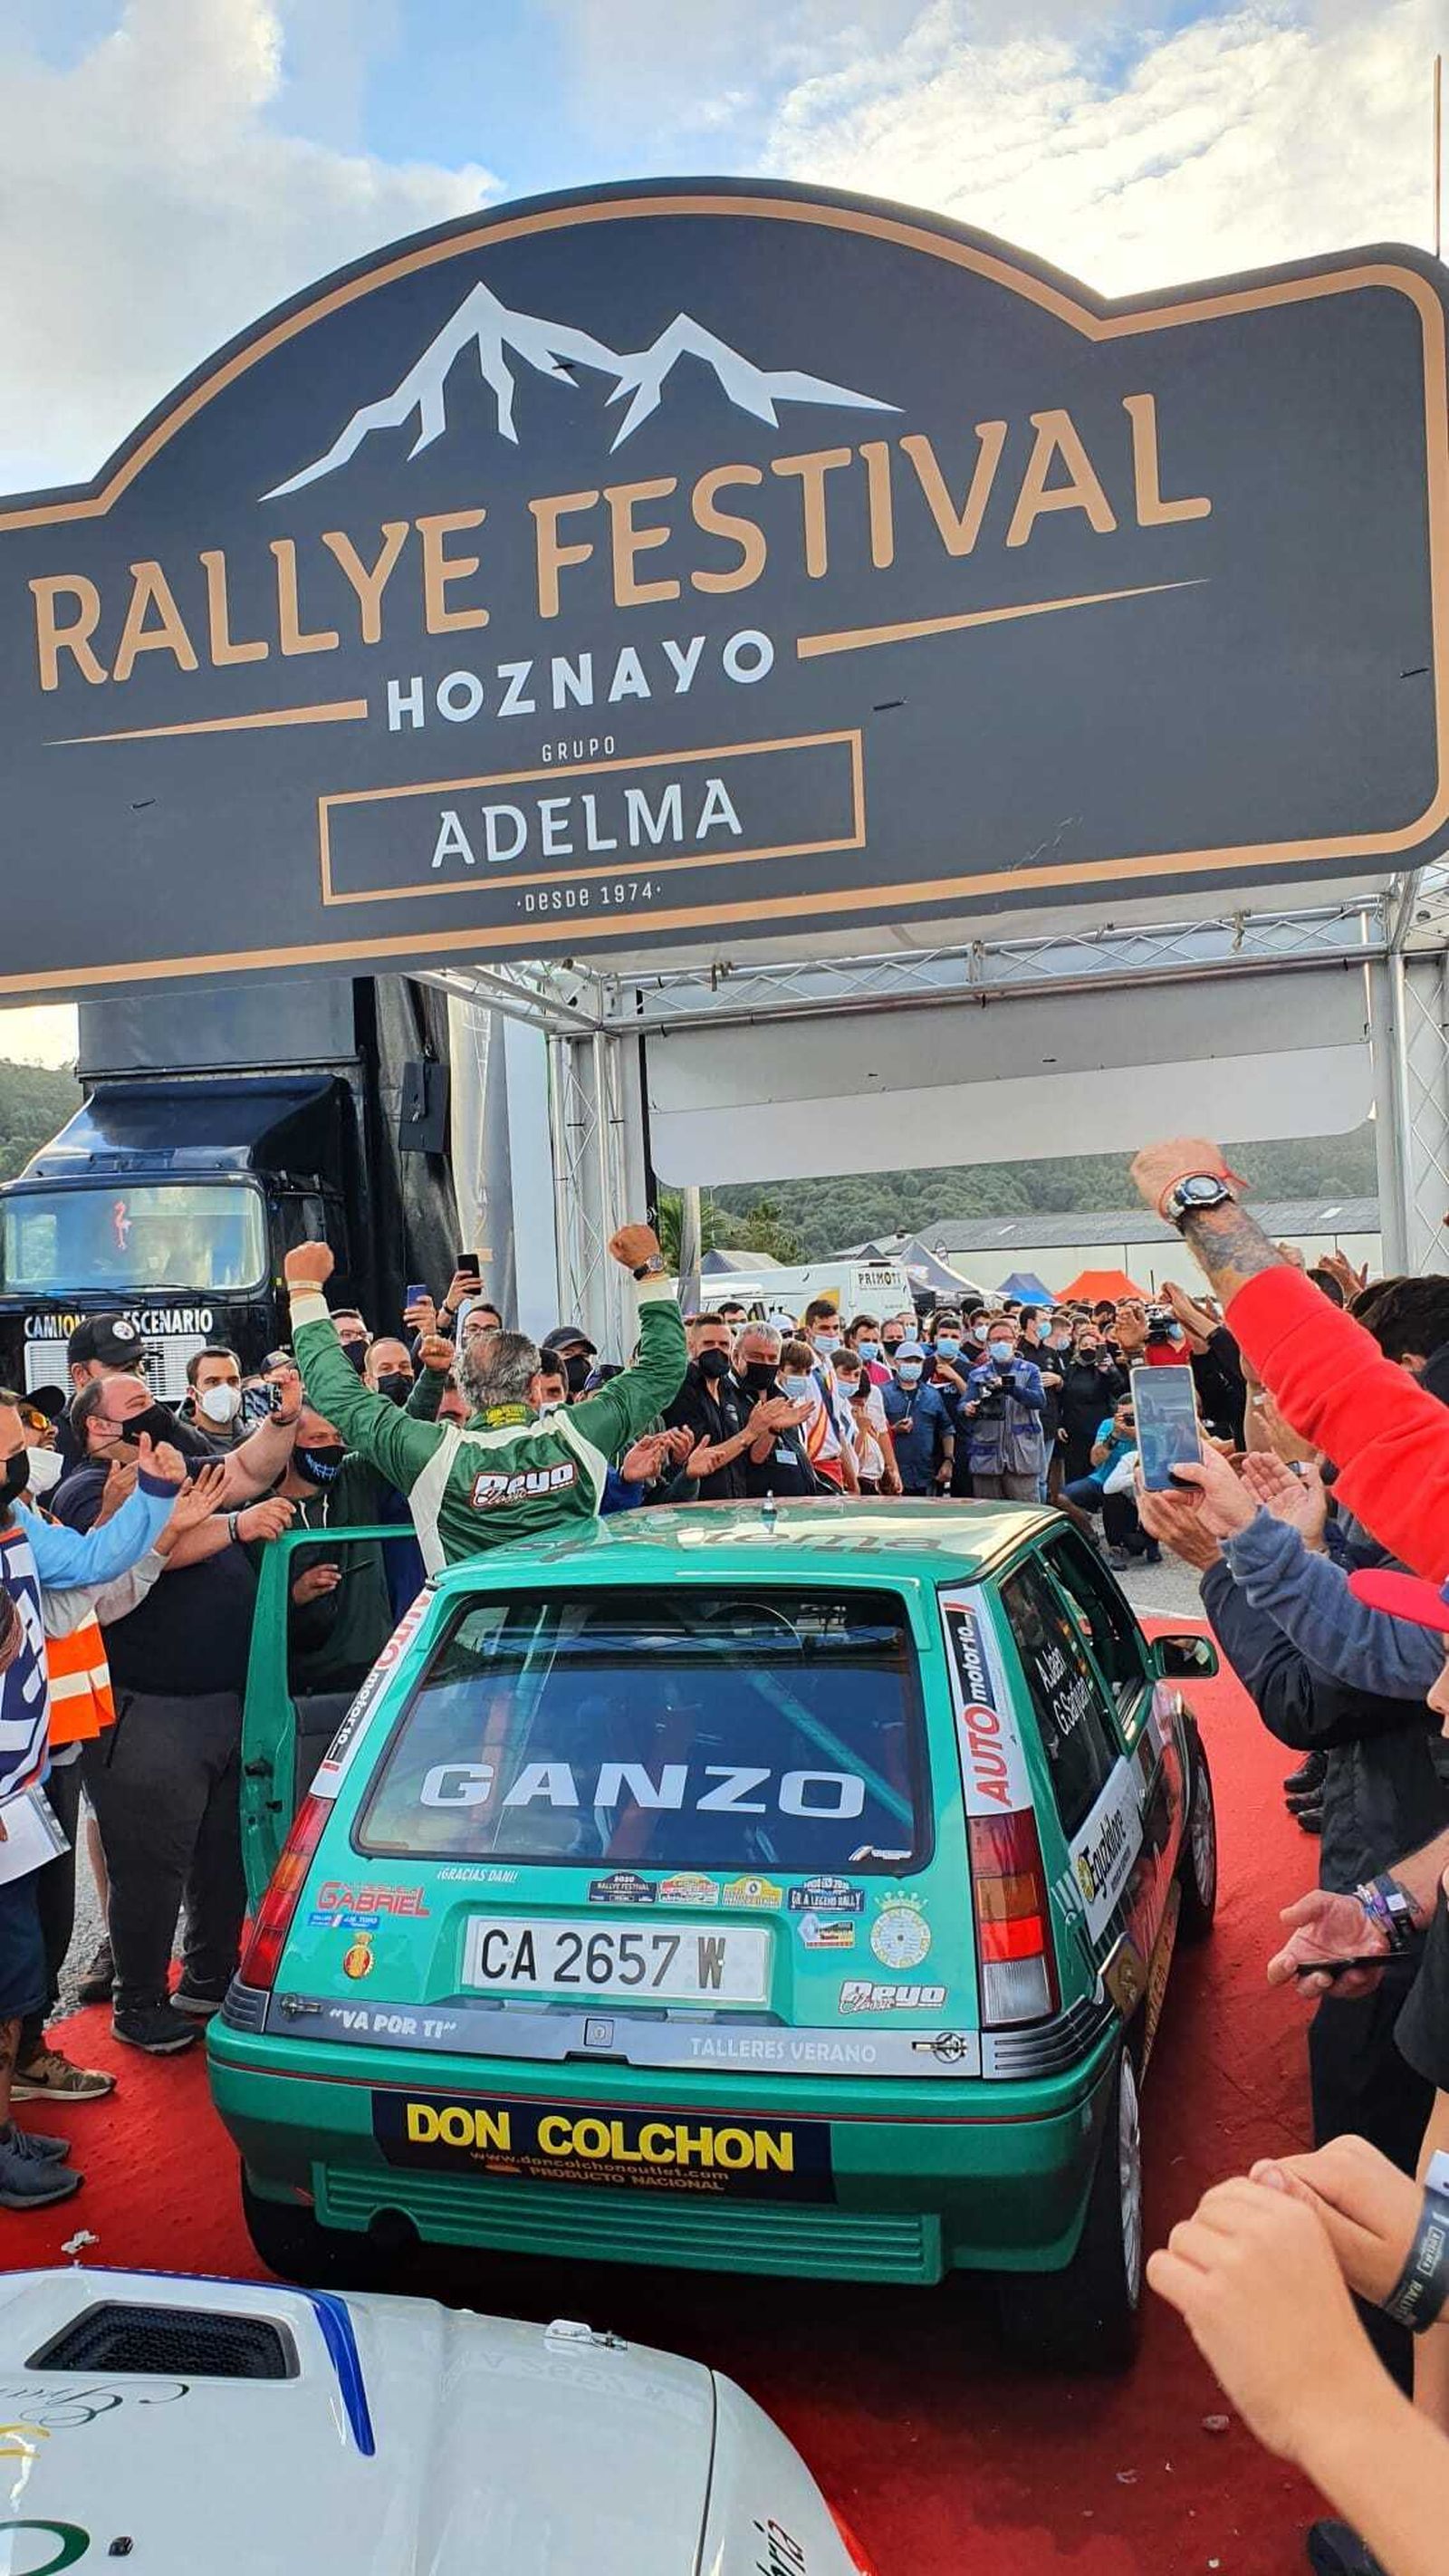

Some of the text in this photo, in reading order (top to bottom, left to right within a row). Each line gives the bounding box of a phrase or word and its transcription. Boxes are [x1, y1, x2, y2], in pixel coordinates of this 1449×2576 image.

[29, 394, 1212, 691] RALLYE FESTIVAL
[387, 630, 774, 731] HOZNAYO
[542, 735, 616, 762] GRUPO
[431, 779, 743, 868] ADELMA
[421, 1762, 864, 1818] GANZO
[318, 1882, 429, 1918] GABRIEL
[481, 1929, 725, 1990] CA 2657 W
[374, 2016, 417, 2034] POR
[691, 2038, 876, 2062] TALLERES VERANO
[407, 2103, 794, 2172] DON COLCHON
[530, 2167, 724, 2191] PRODUCTO NACIONAL
